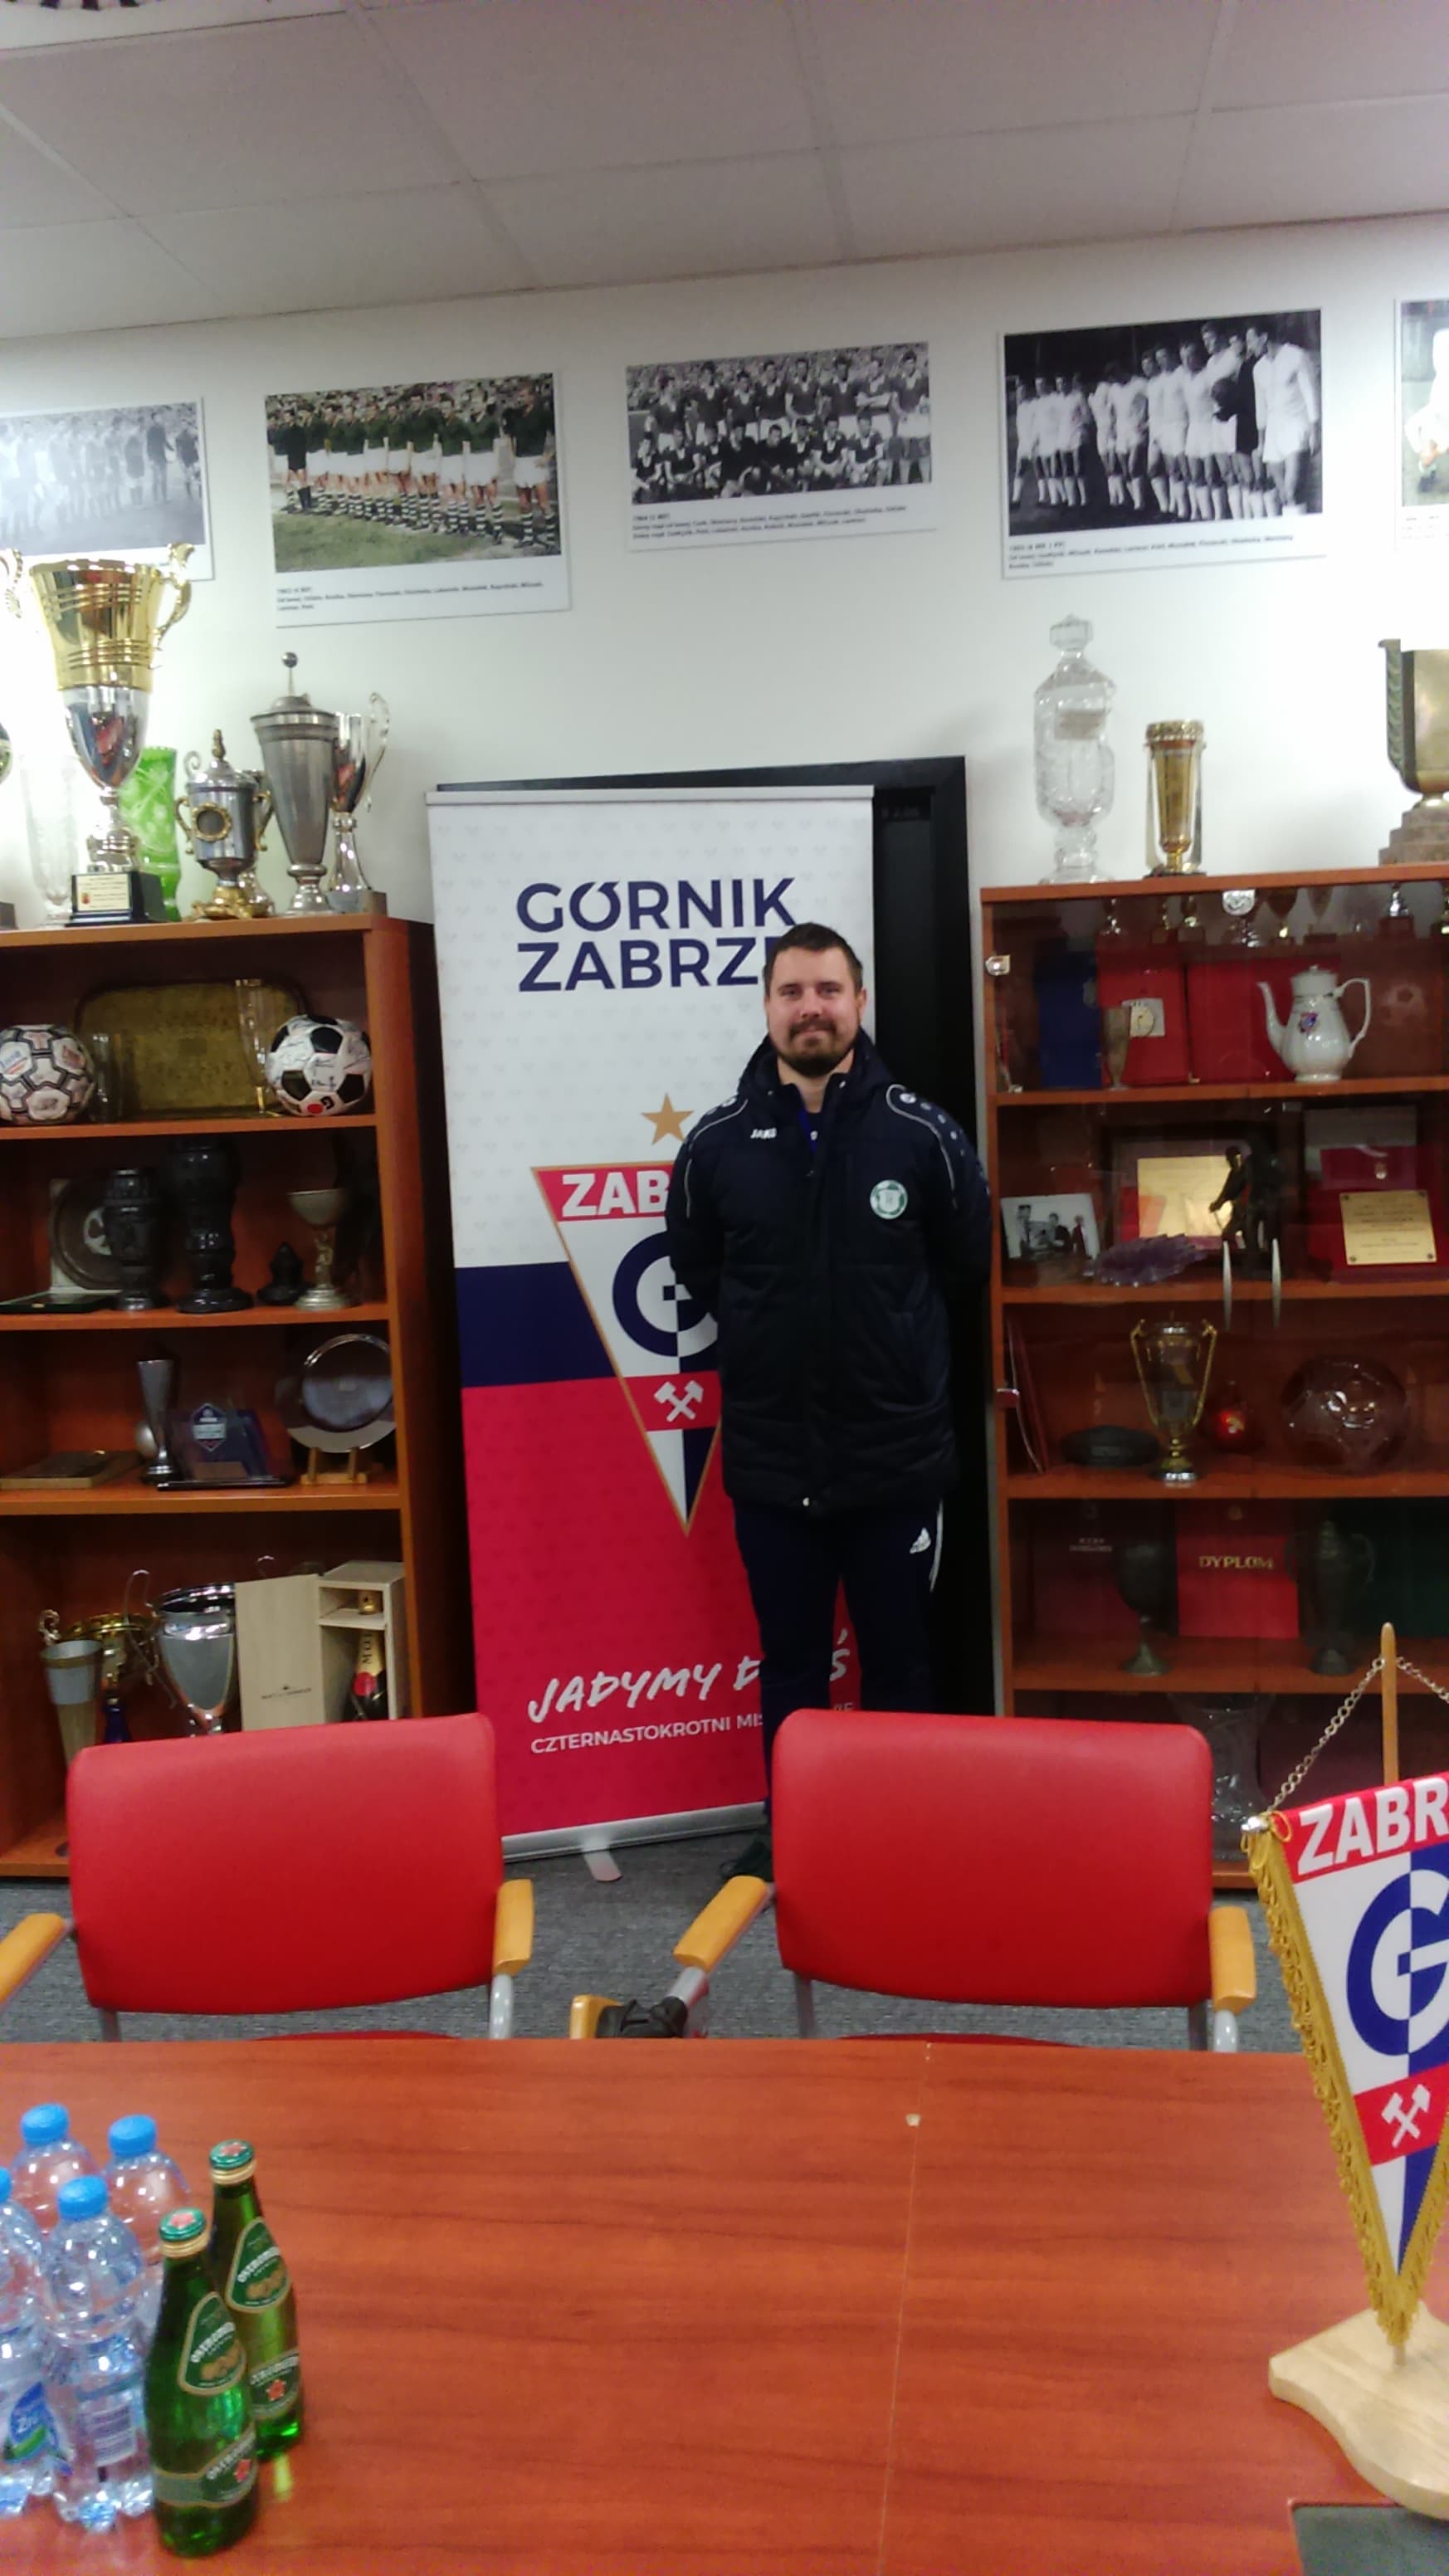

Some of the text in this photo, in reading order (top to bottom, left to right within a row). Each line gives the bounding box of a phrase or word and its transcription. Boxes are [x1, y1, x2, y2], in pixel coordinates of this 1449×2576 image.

[516, 877, 796, 933] GÓRNIK
[562, 1170, 670, 1217] ZAB
[1198, 1555, 1274, 1569] DYPLOM
[527, 1662, 722, 1723] JADYMY
[530, 1715, 731, 1754] CZTERNASTOKROTNI
[1297, 1777, 1449, 1876] ZABR
